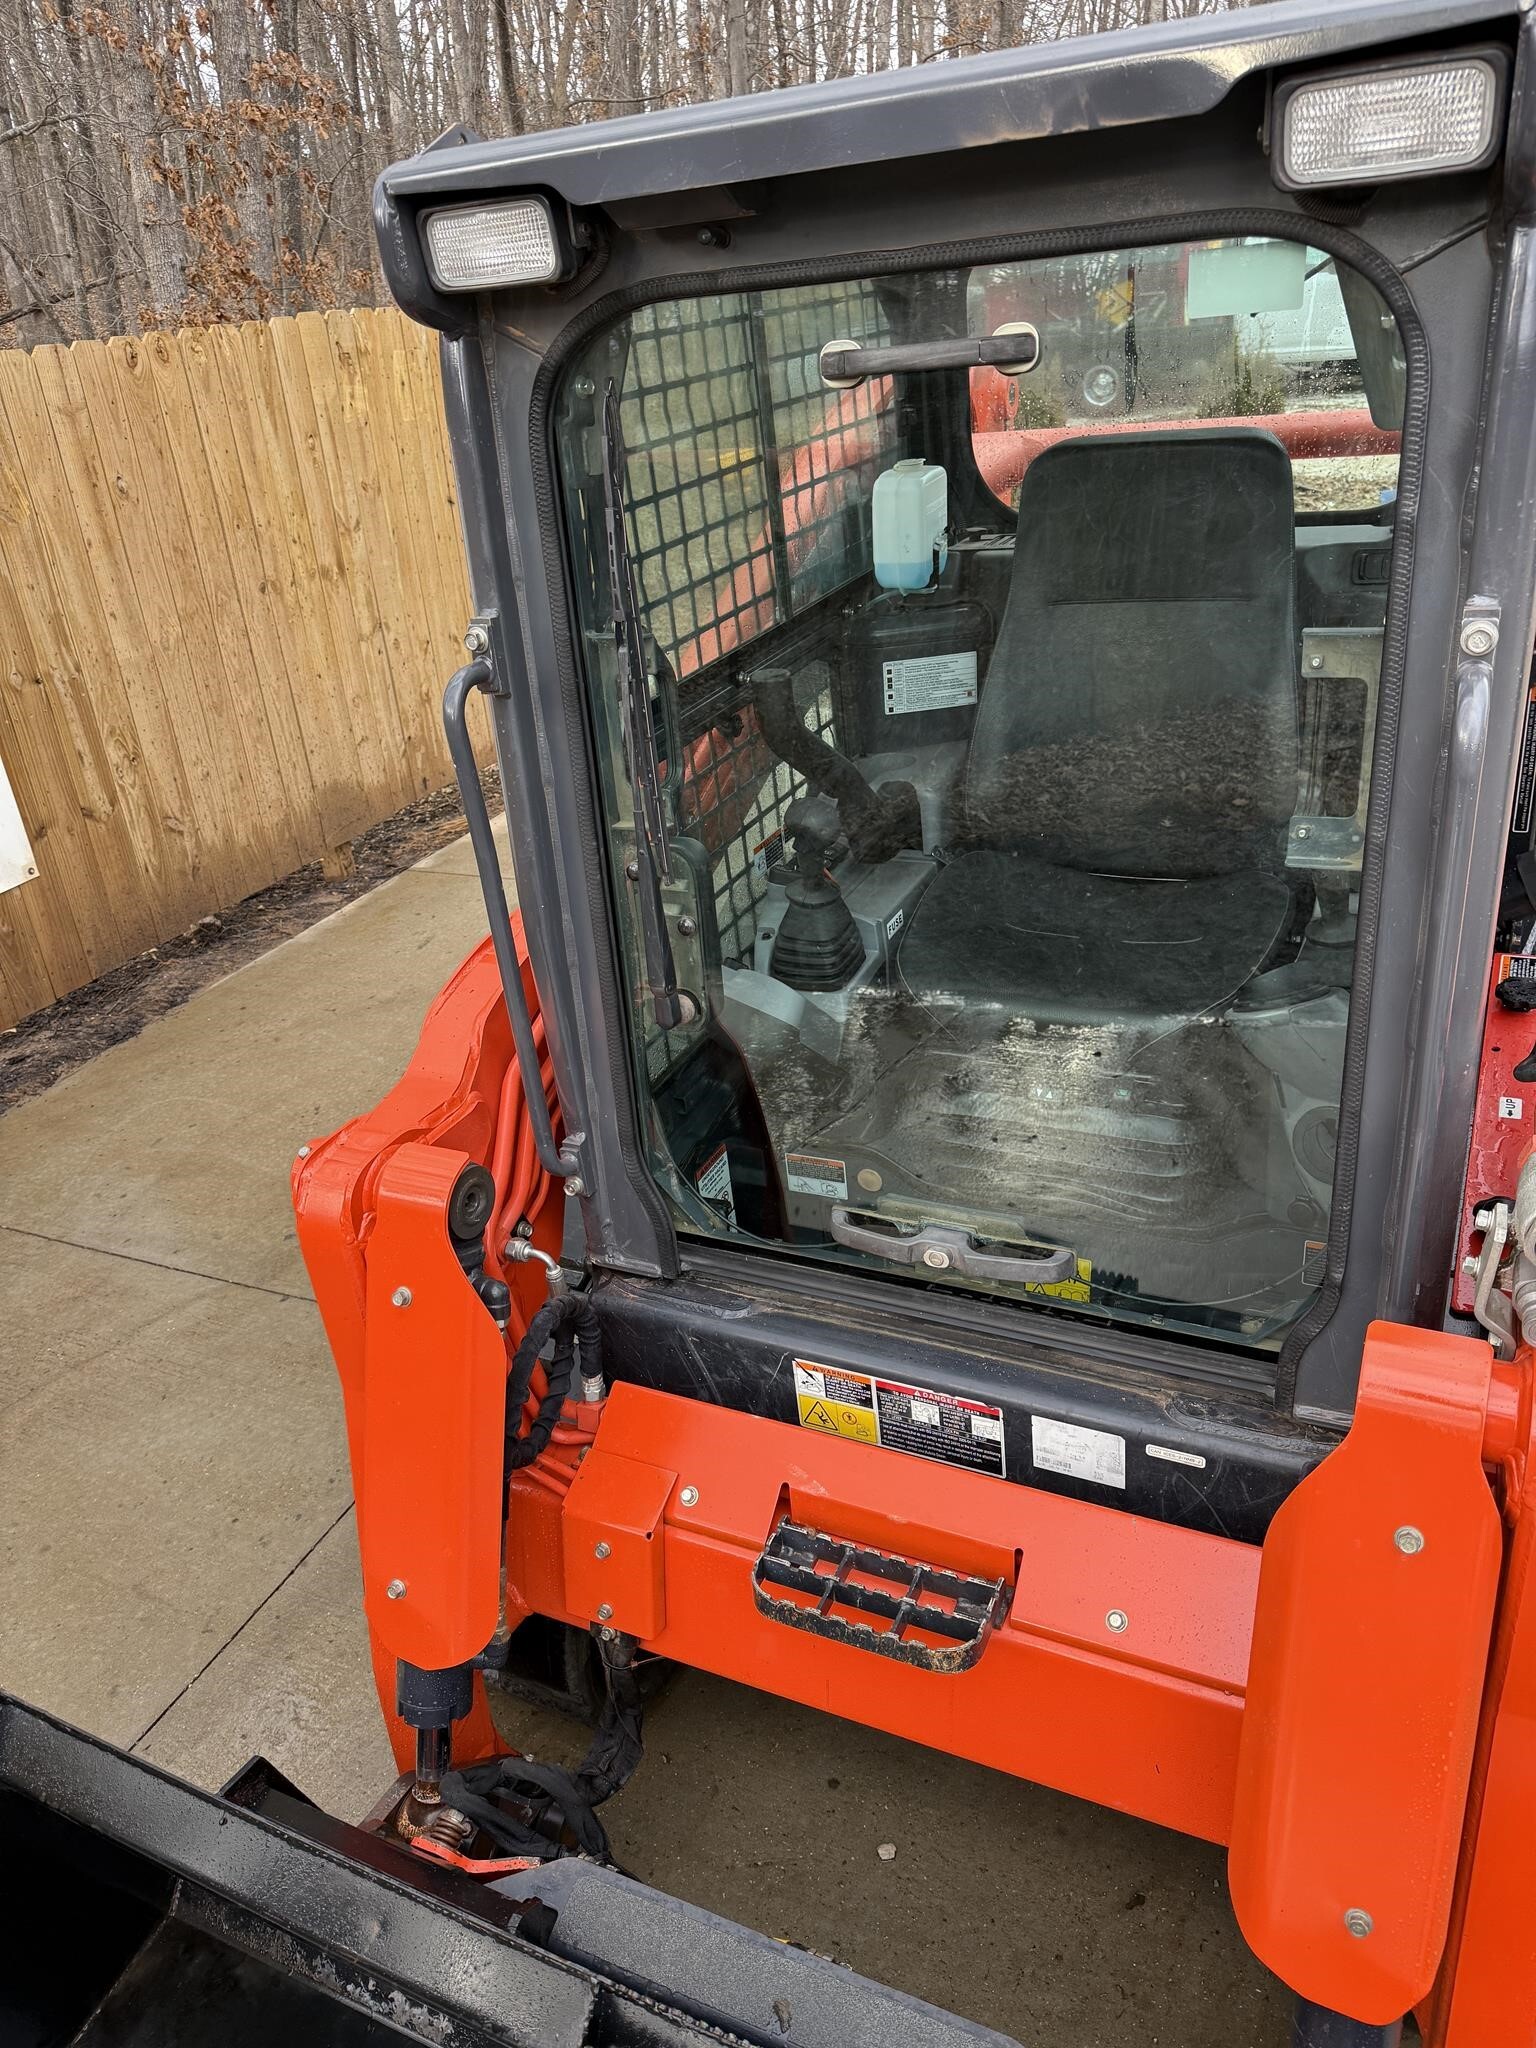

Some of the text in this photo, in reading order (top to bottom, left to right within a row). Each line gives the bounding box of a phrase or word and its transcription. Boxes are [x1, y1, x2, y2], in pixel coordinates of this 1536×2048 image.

[889, 913, 902, 935] FUSE
[1505, 1099, 1516, 1109] UP
[915, 1396, 938, 1406] PERSONAL
[923, 1393, 958, 1405] DANGER
